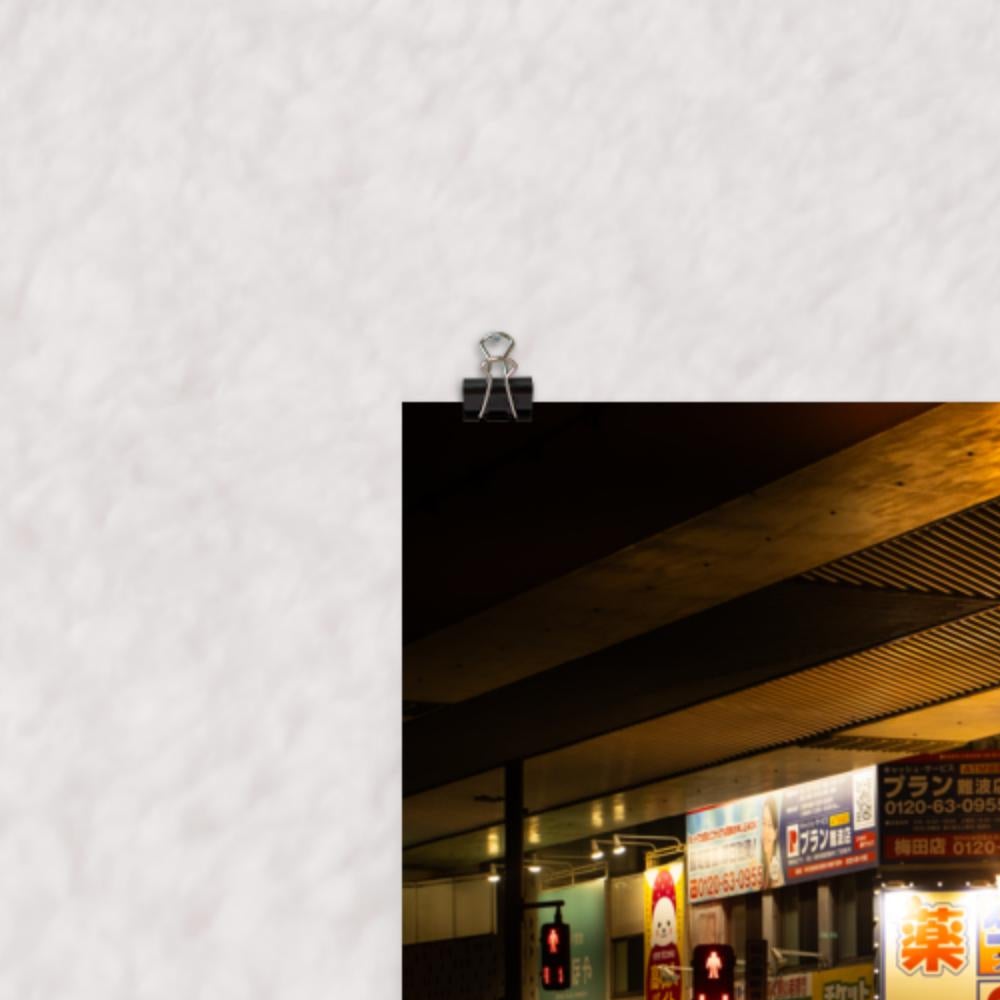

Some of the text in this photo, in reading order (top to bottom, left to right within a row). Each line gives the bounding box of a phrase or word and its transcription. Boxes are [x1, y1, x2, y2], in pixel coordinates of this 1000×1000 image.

[895, 837, 946, 856] 梅田店
[901, 907, 966, 973] 薬
